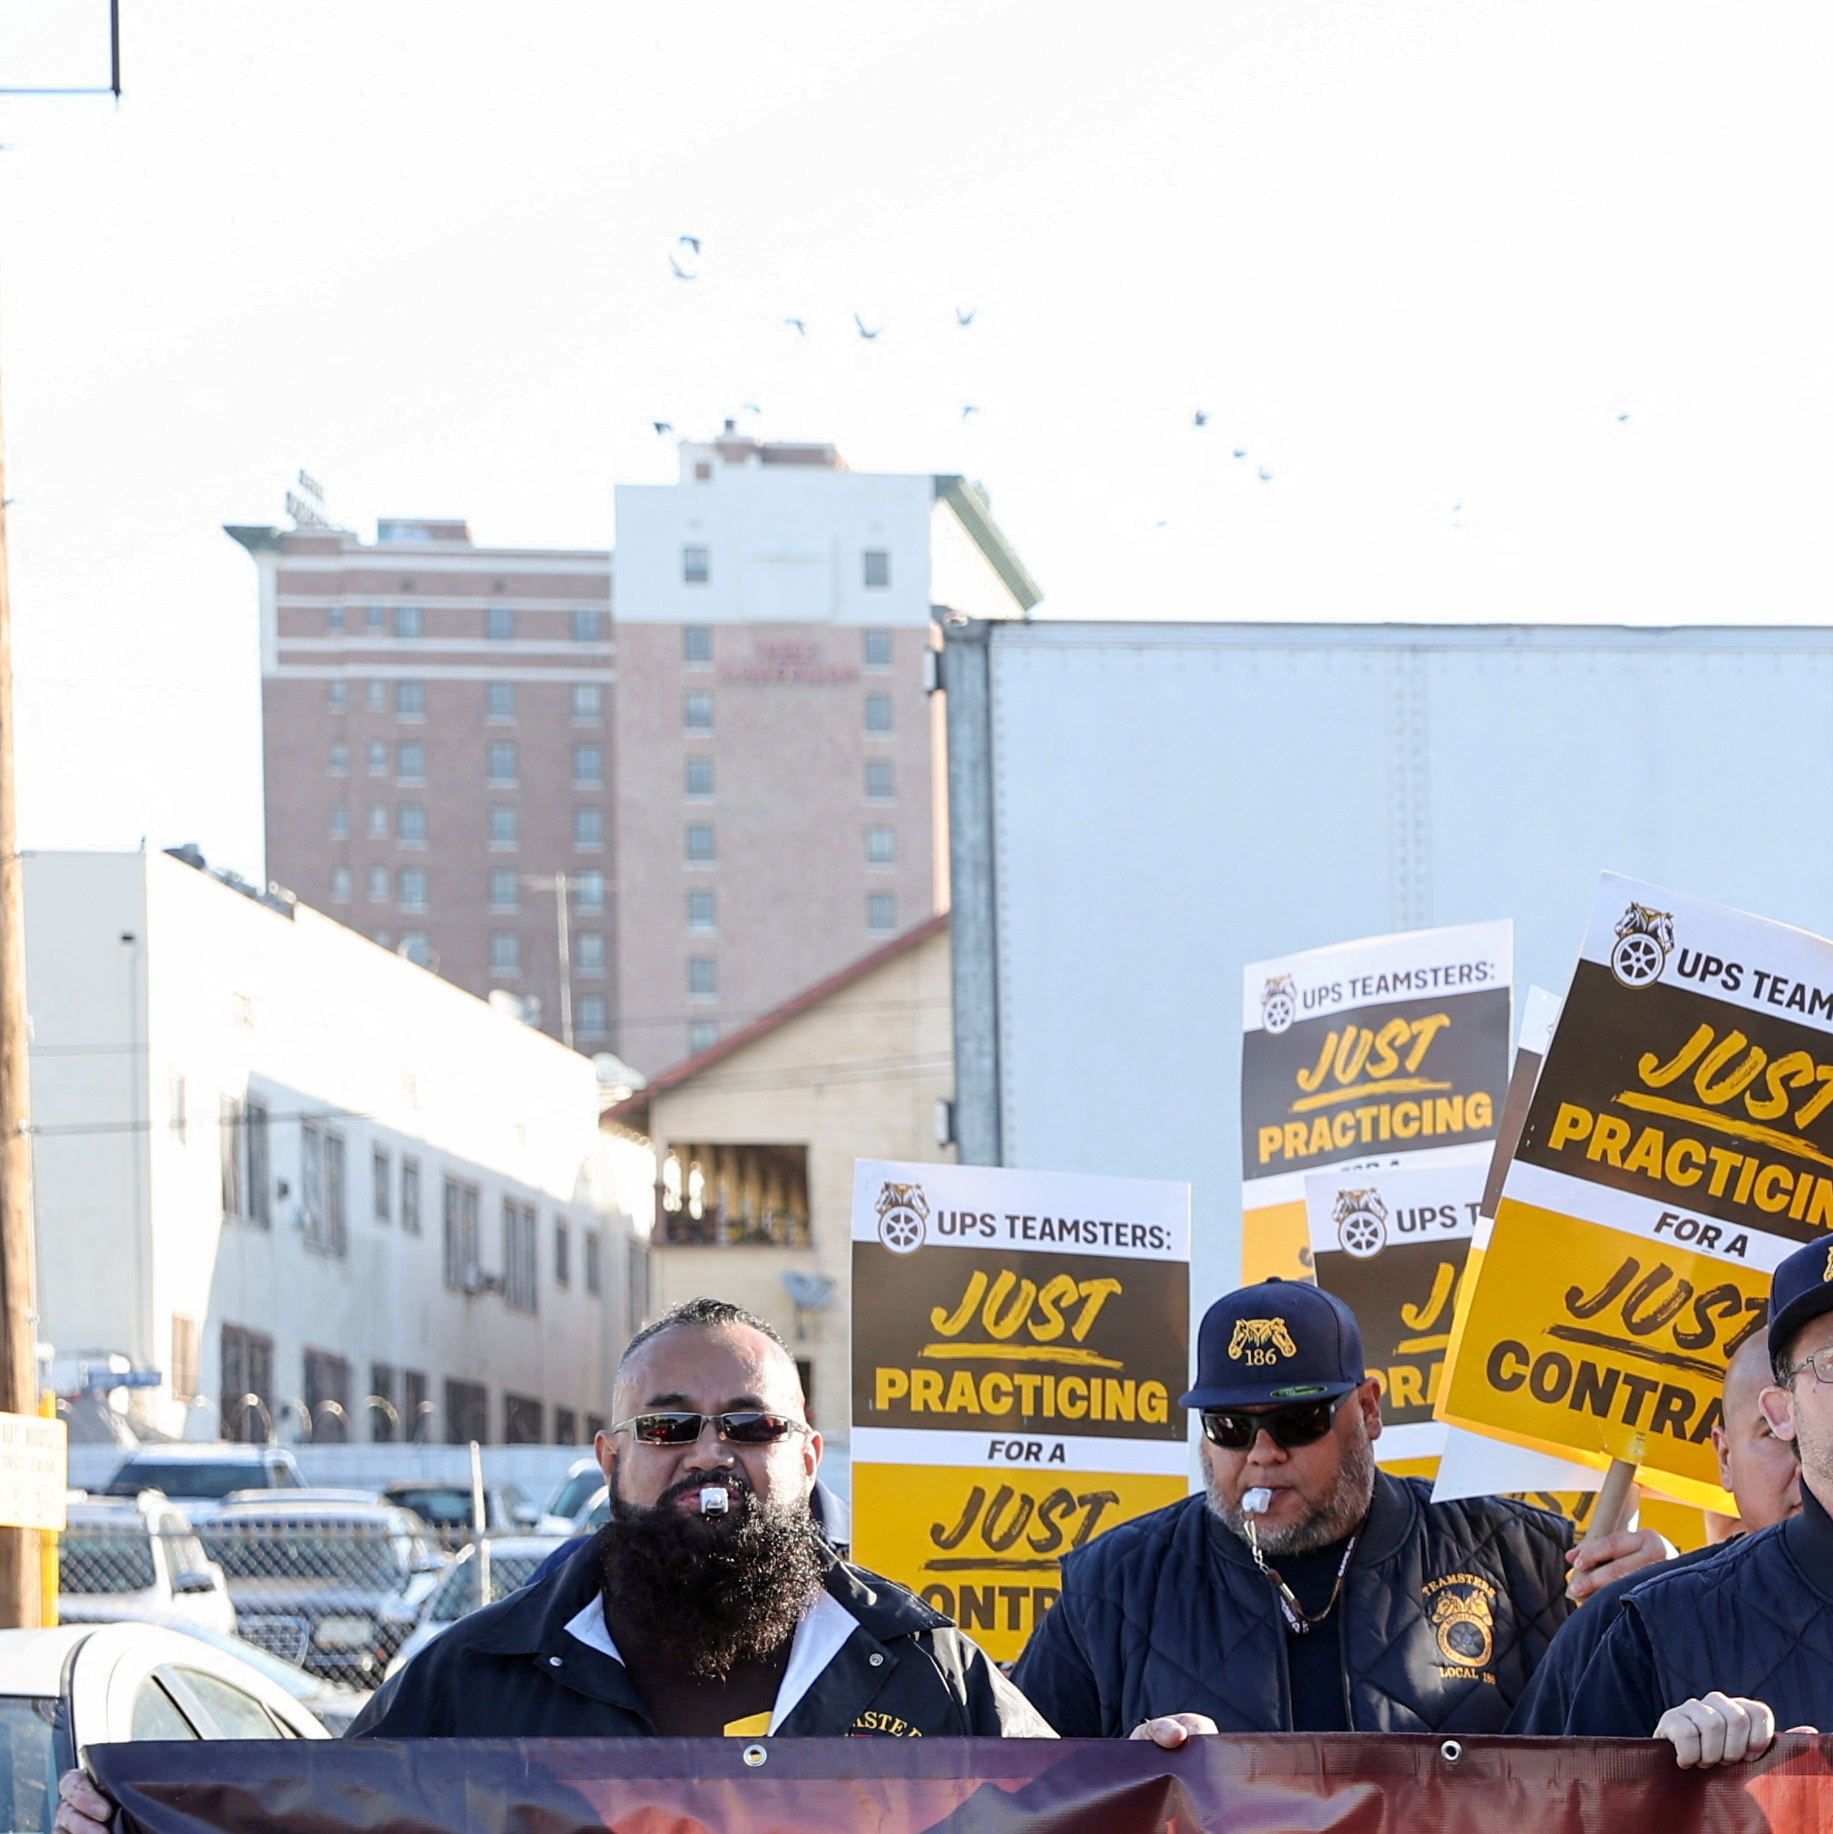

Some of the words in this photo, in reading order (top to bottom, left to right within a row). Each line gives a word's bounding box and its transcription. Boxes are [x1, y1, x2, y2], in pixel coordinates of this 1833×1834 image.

[1302, 982, 1342, 1008] UPS
[1349, 962, 1494, 1000] TEAMSTERS:
[1677, 949, 1741, 991] UPS
[1299, 1014, 1450, 1092] JUST
[1258, 1093, 1492, 1162] PRACTICING
[937, 1211, 996, 1237] UPS
[1006, 1215, 1172, 1251] TEAMSTERS:
[1398, 1207, 1451, 1232] UPS
[1654, 1212, 1721, 1252] FOR
[1721, 1235, 1749, 1259] A
[930, 1269, 1122, 1342] JUST
[1244, 1348, 1277, 1367] 186
[875, 1368, 1168, 1423] PRACTICING
[1486, 1341, 1722, 1444] CONTRA
[987, 1440, 1042, 1463] FOR
[1046, 1443, 1066, 1463] A
[930, 1484, 1121, 1551] JUST
[1440, 1667, 1479, 1679] LOCAL
